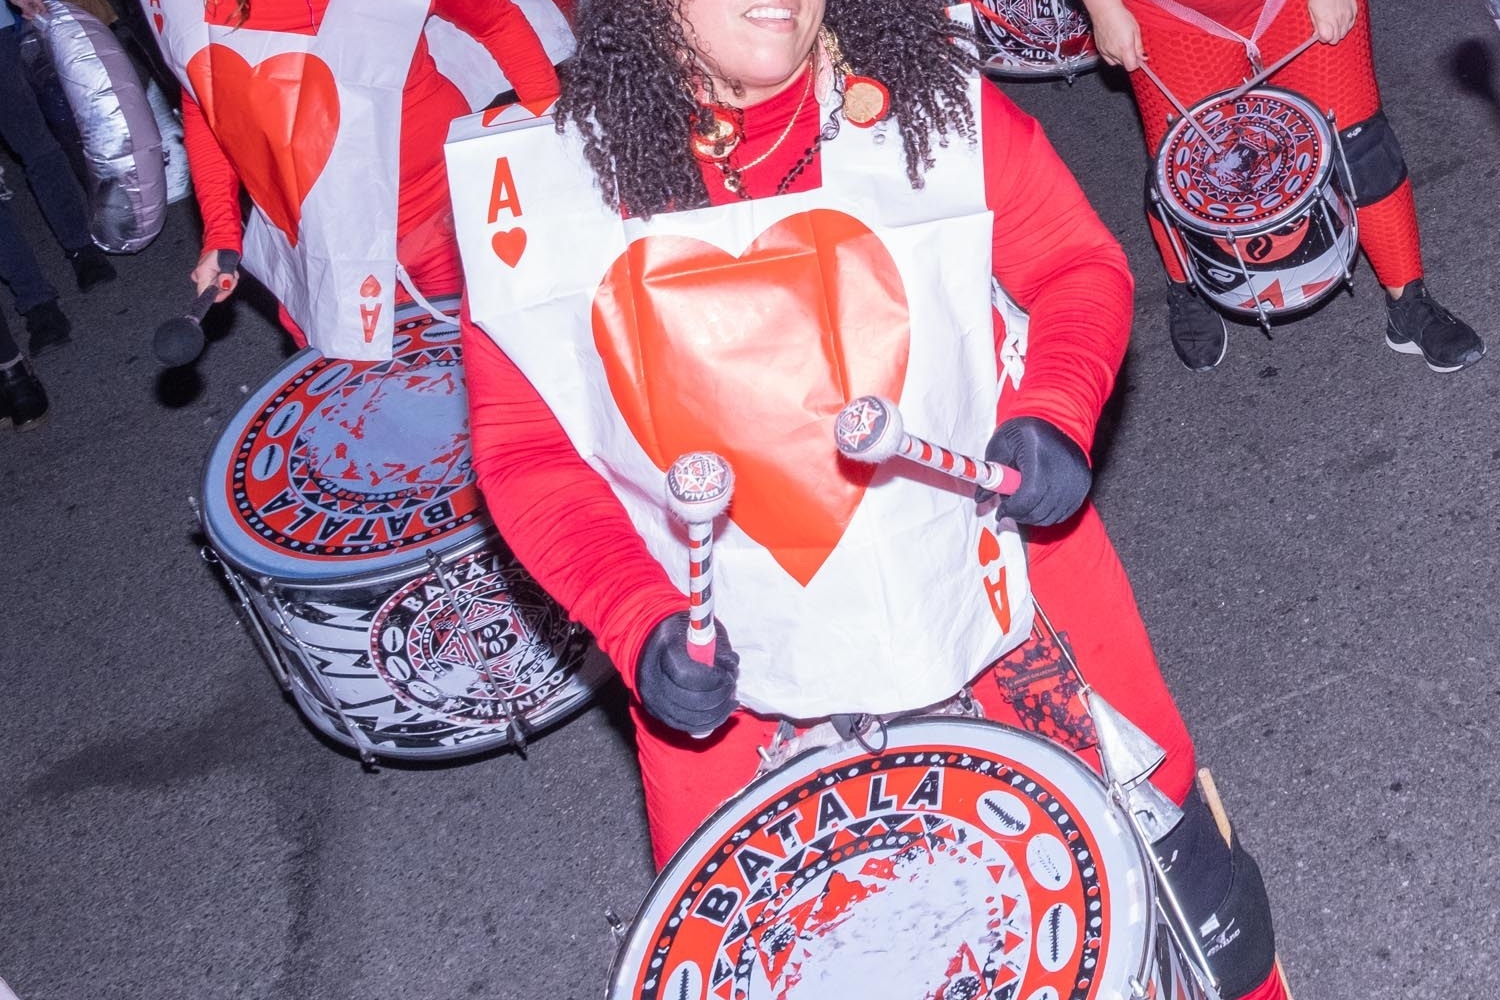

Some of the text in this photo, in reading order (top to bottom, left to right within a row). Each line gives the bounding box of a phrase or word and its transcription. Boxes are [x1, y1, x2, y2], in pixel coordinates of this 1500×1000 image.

[1235, 101, 1312, 146] BATALA
[487, 156, 523, 224] A
[359, 302, 383, 344] A
[258, 485, 456, 544] BATALA
[980, 573, 1011, 635] A
[691, 767, 945, 928] BATALA
